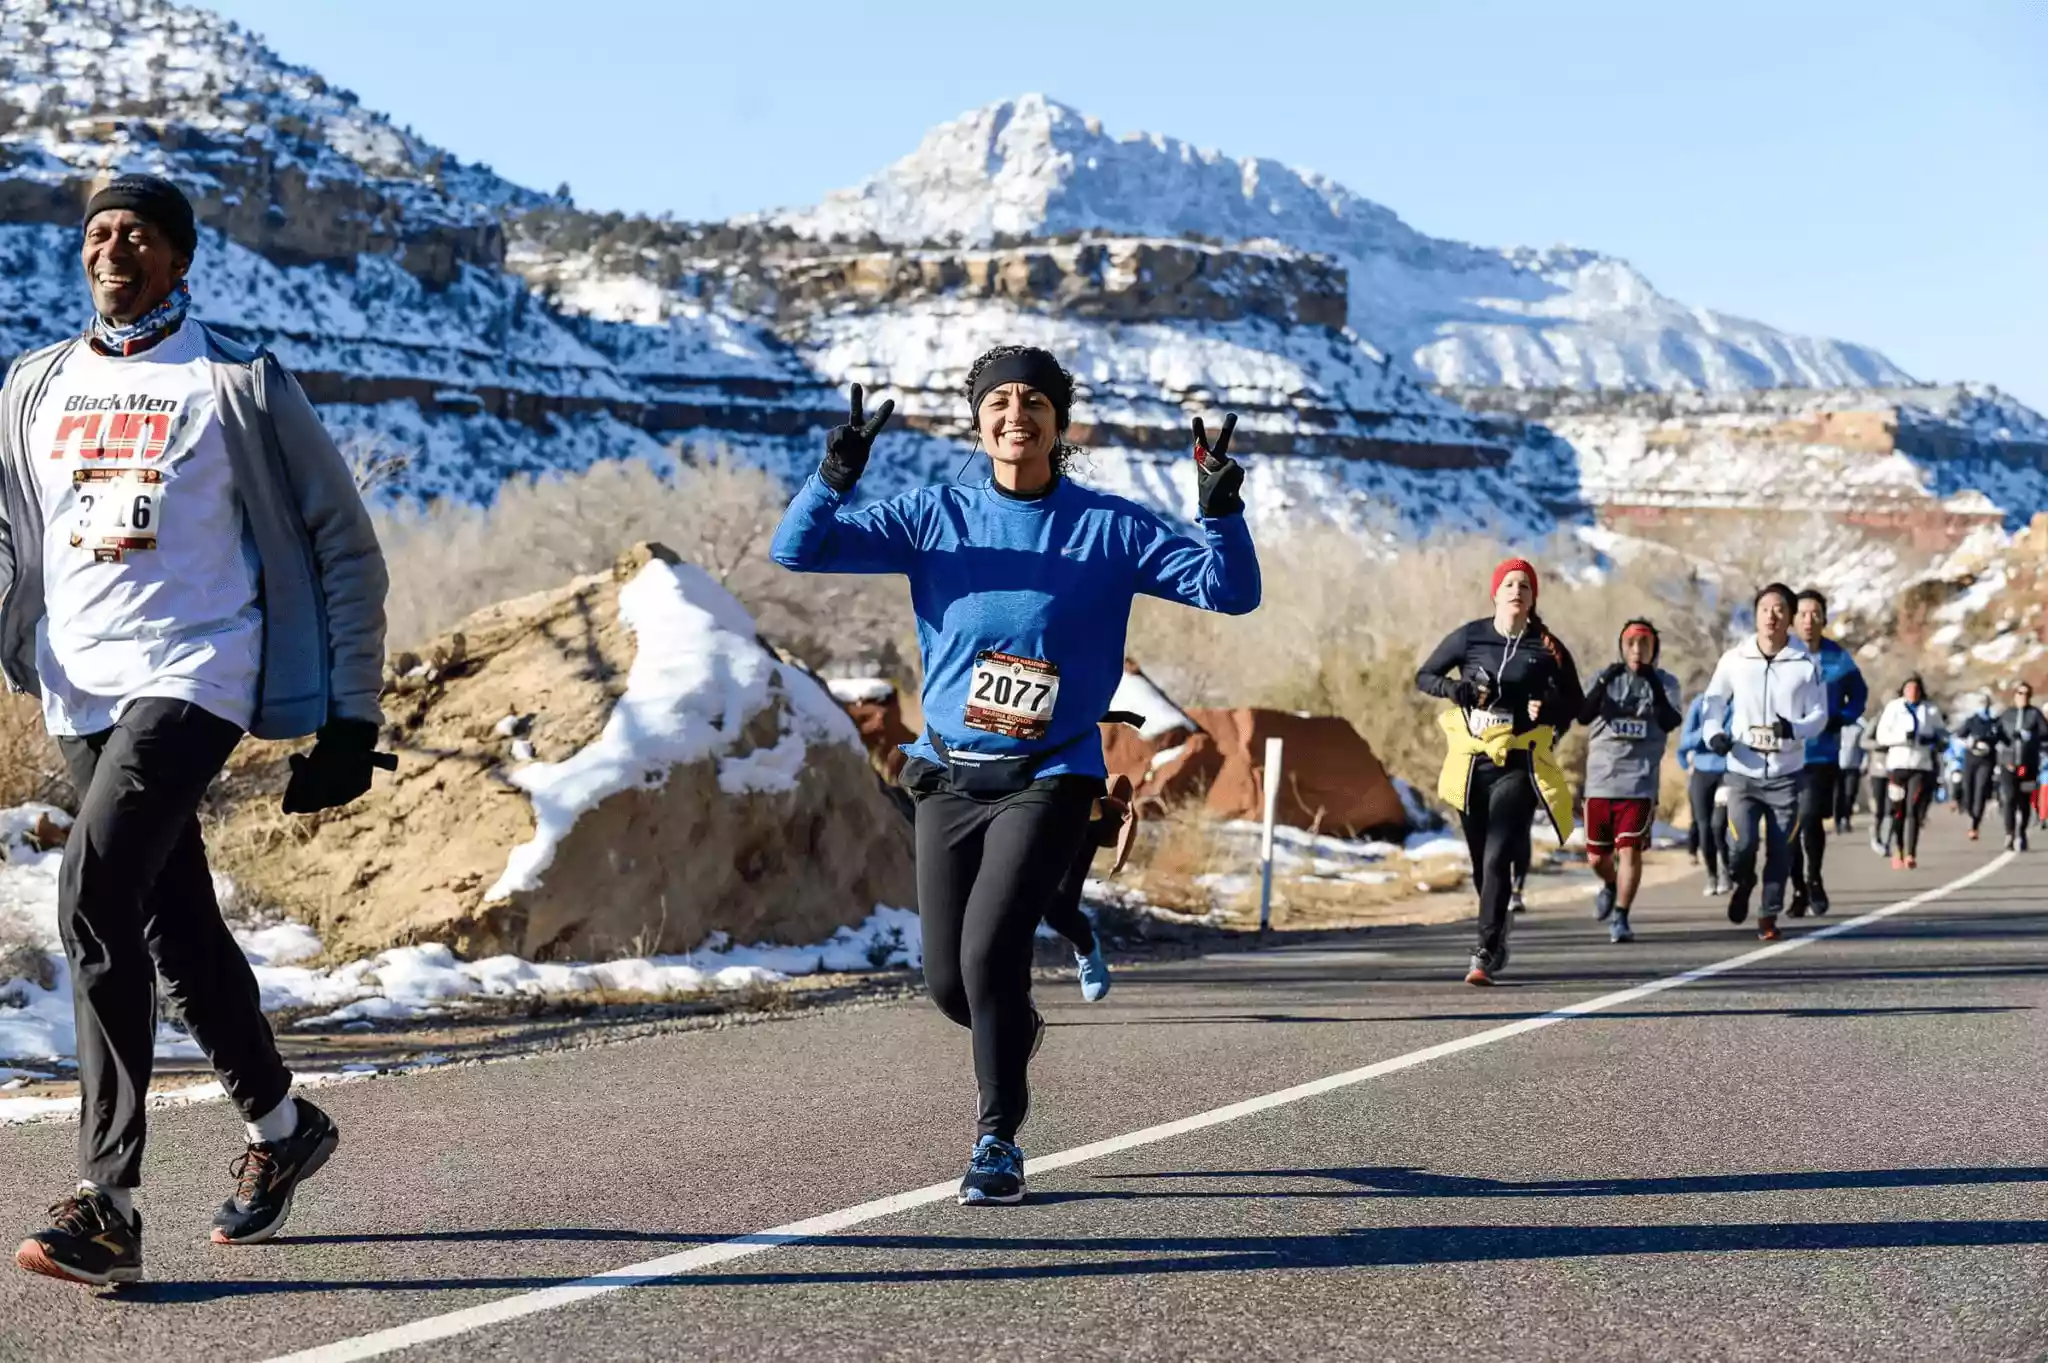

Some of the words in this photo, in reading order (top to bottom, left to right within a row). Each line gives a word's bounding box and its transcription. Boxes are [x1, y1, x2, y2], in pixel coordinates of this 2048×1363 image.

[64, 394, 121, 412] Black
[124, 394, 178, 412] Men
[50, 413, 170, 459] run
[975, 671, 1051, 712] 2077
